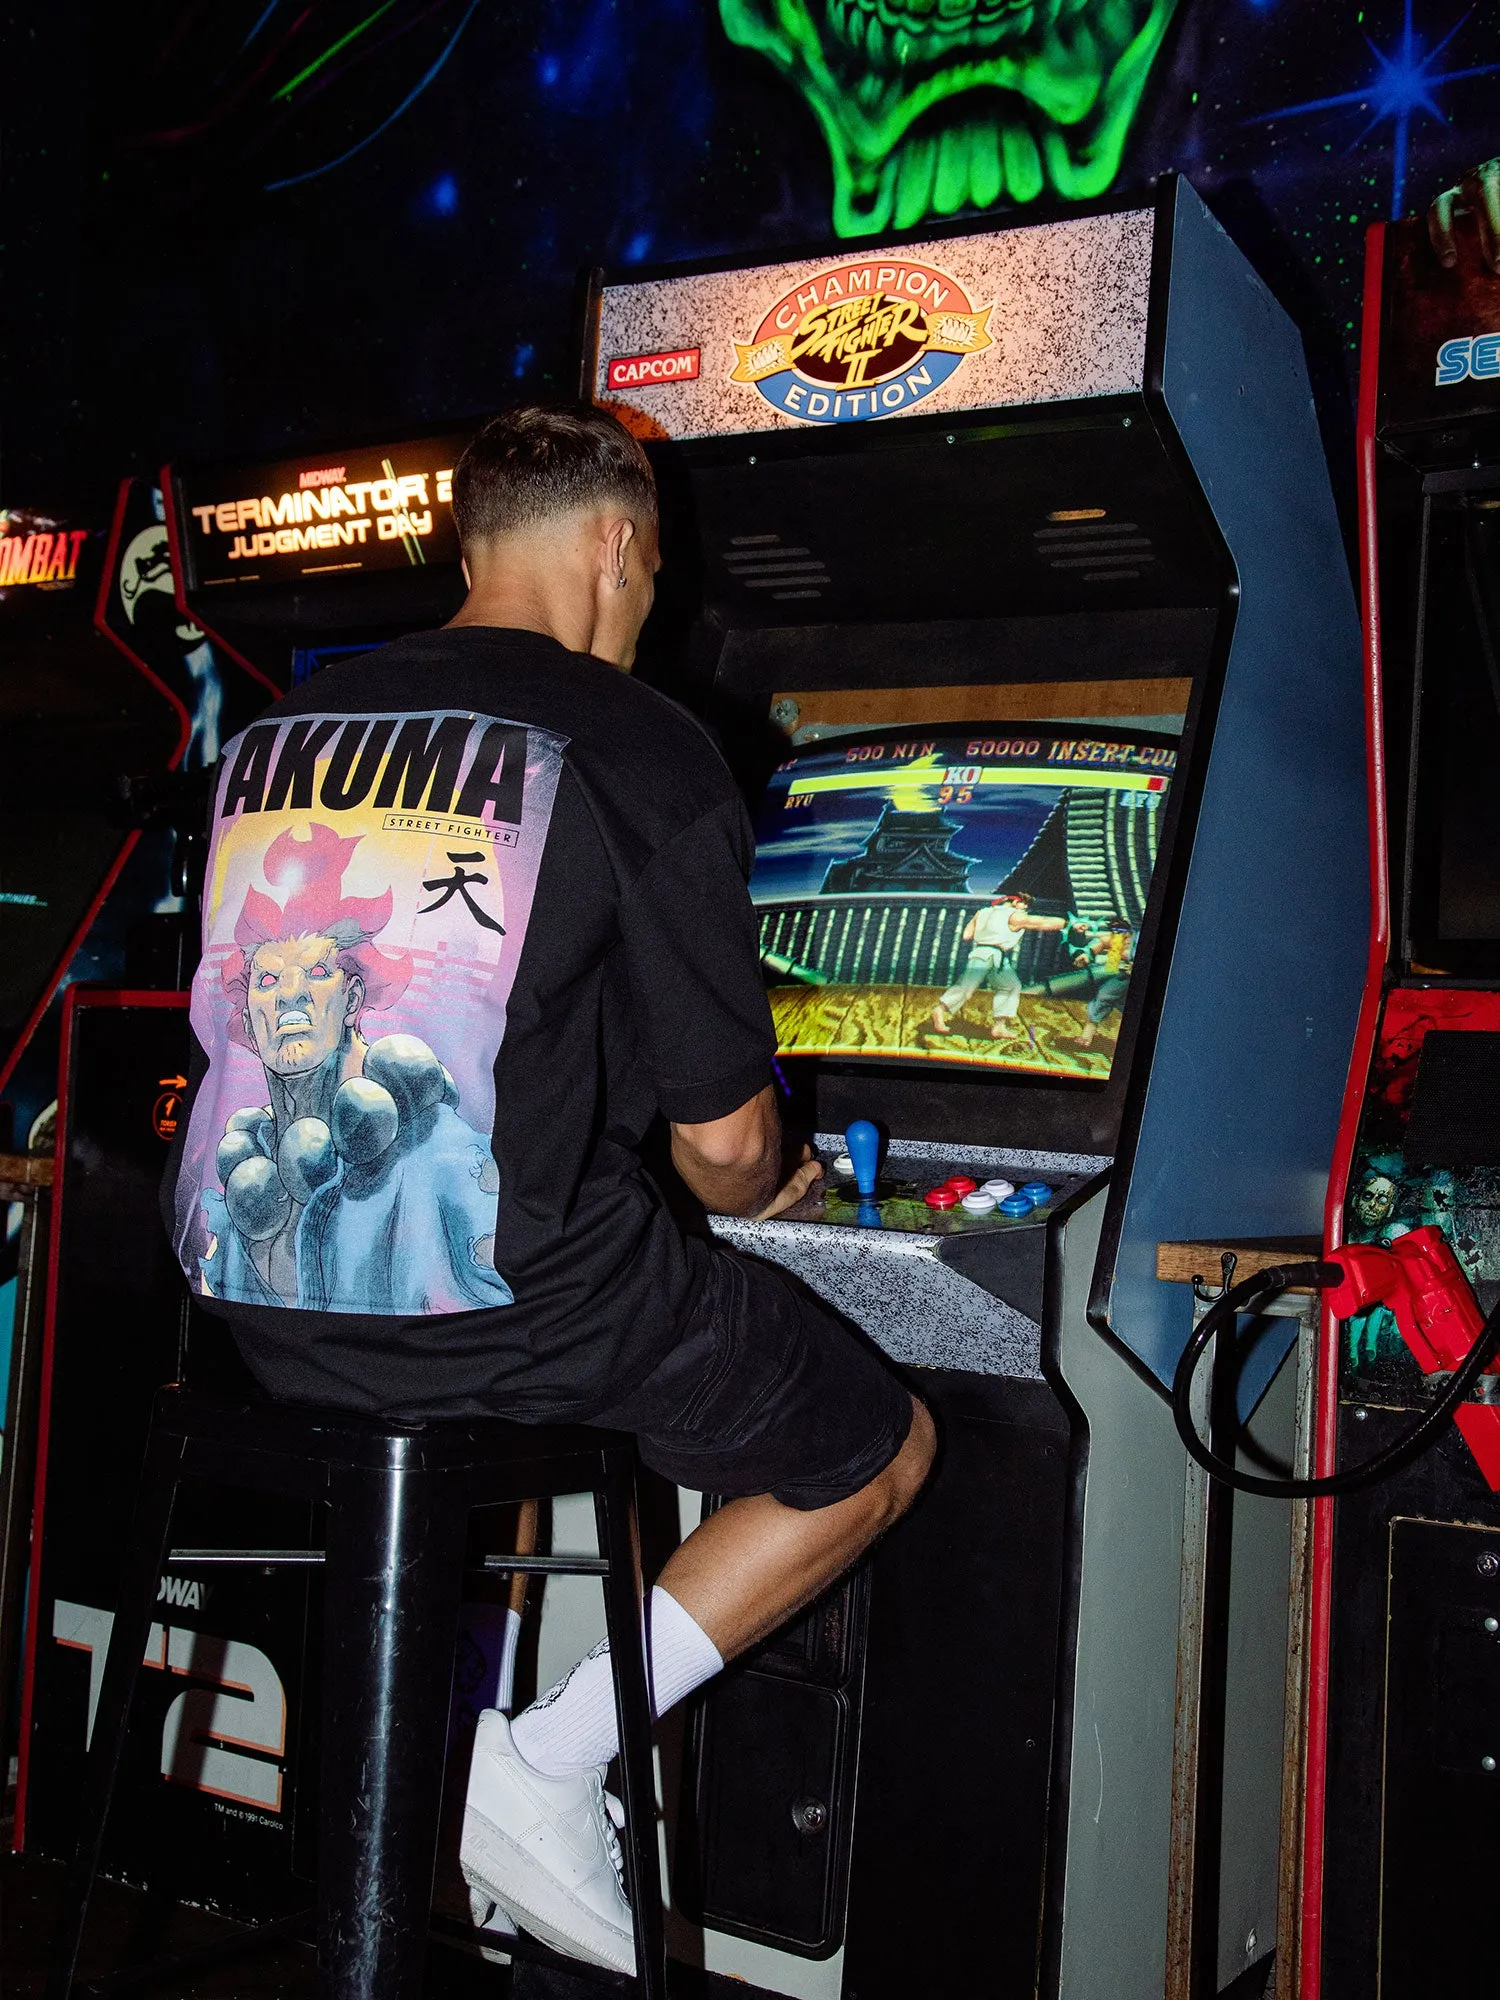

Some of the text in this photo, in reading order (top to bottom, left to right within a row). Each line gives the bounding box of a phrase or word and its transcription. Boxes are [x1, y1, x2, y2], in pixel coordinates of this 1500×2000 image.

[775, 267, 950, 329] CHAMPION
[791, 291, 885, 361] STREET
[806, 299, 928, 363] FIGHTER
[613, 355, 693, 383] CAPCOM
[835, 349, 883, 391] II
[783, 364, 933, 418] EDITION
[299, 467, 346, 489] MIDWAY
[192, 474, 429, 534] TERMINATOR
[228, 509, 433, 560] JUDGMENT DAY
[221, 716, 528, 825] AKUMA
[845, 745, 885, 763] 500
[966, 740, 1040, 758] 50000
[1048, 740, 1136, 764] INSERT
[1139, 745, 1177, 767] COI
[937, 786, 975, 805] 95
[942, 766, 983, 784] KO
[783, 794, 815, 810] RYU
[390, 818, 512, 843] STREET FIGHTER
[417, 850, 506, 936] 天
[214, 1802, 225, 1813] TM
[225, 1807, 238, 1817] and
[259, 1815, 284, 1830] Carolco
